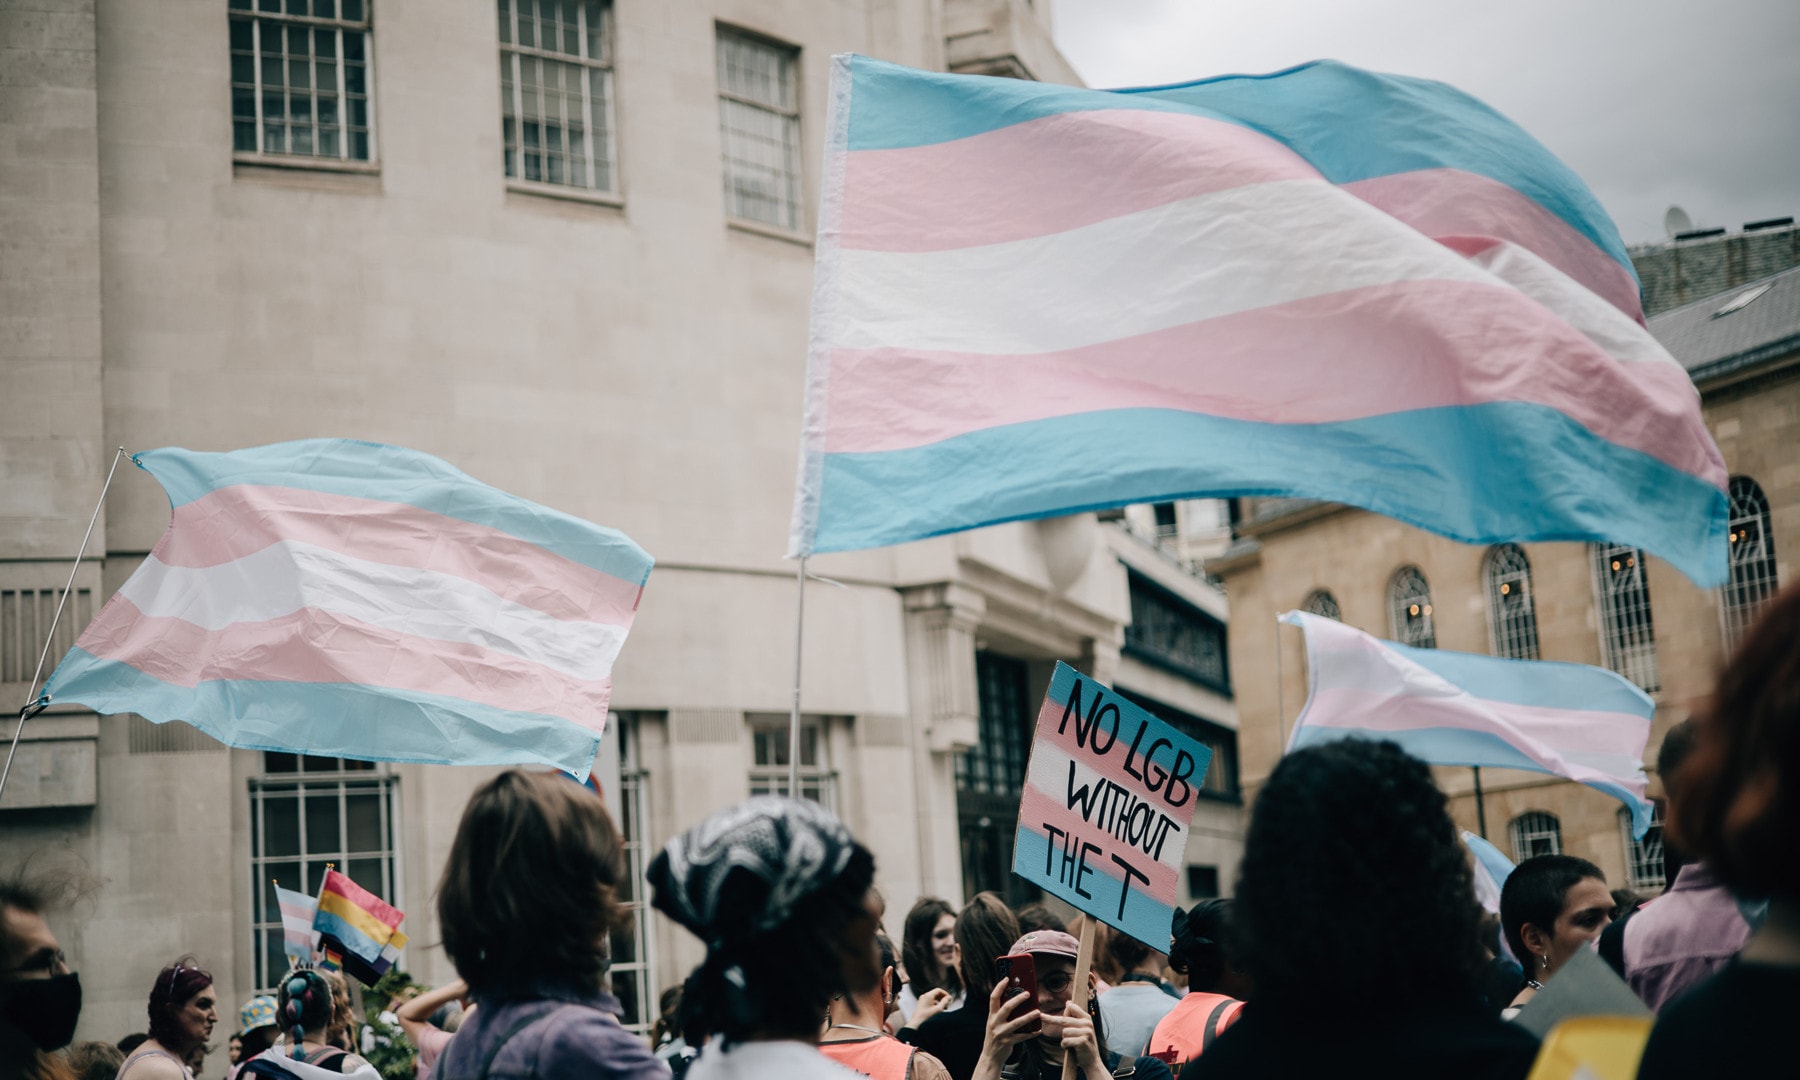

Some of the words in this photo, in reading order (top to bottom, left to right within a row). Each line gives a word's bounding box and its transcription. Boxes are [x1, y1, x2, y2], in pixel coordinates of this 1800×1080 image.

[1058, 679, 1120, 755] NO
[1123, 720, 1195, 807] LGB
[1067, 760, 1180, 862] WITHOUT
[1043, 823, 1102, 900] THE
[1111, 853, 1150, 921] T
